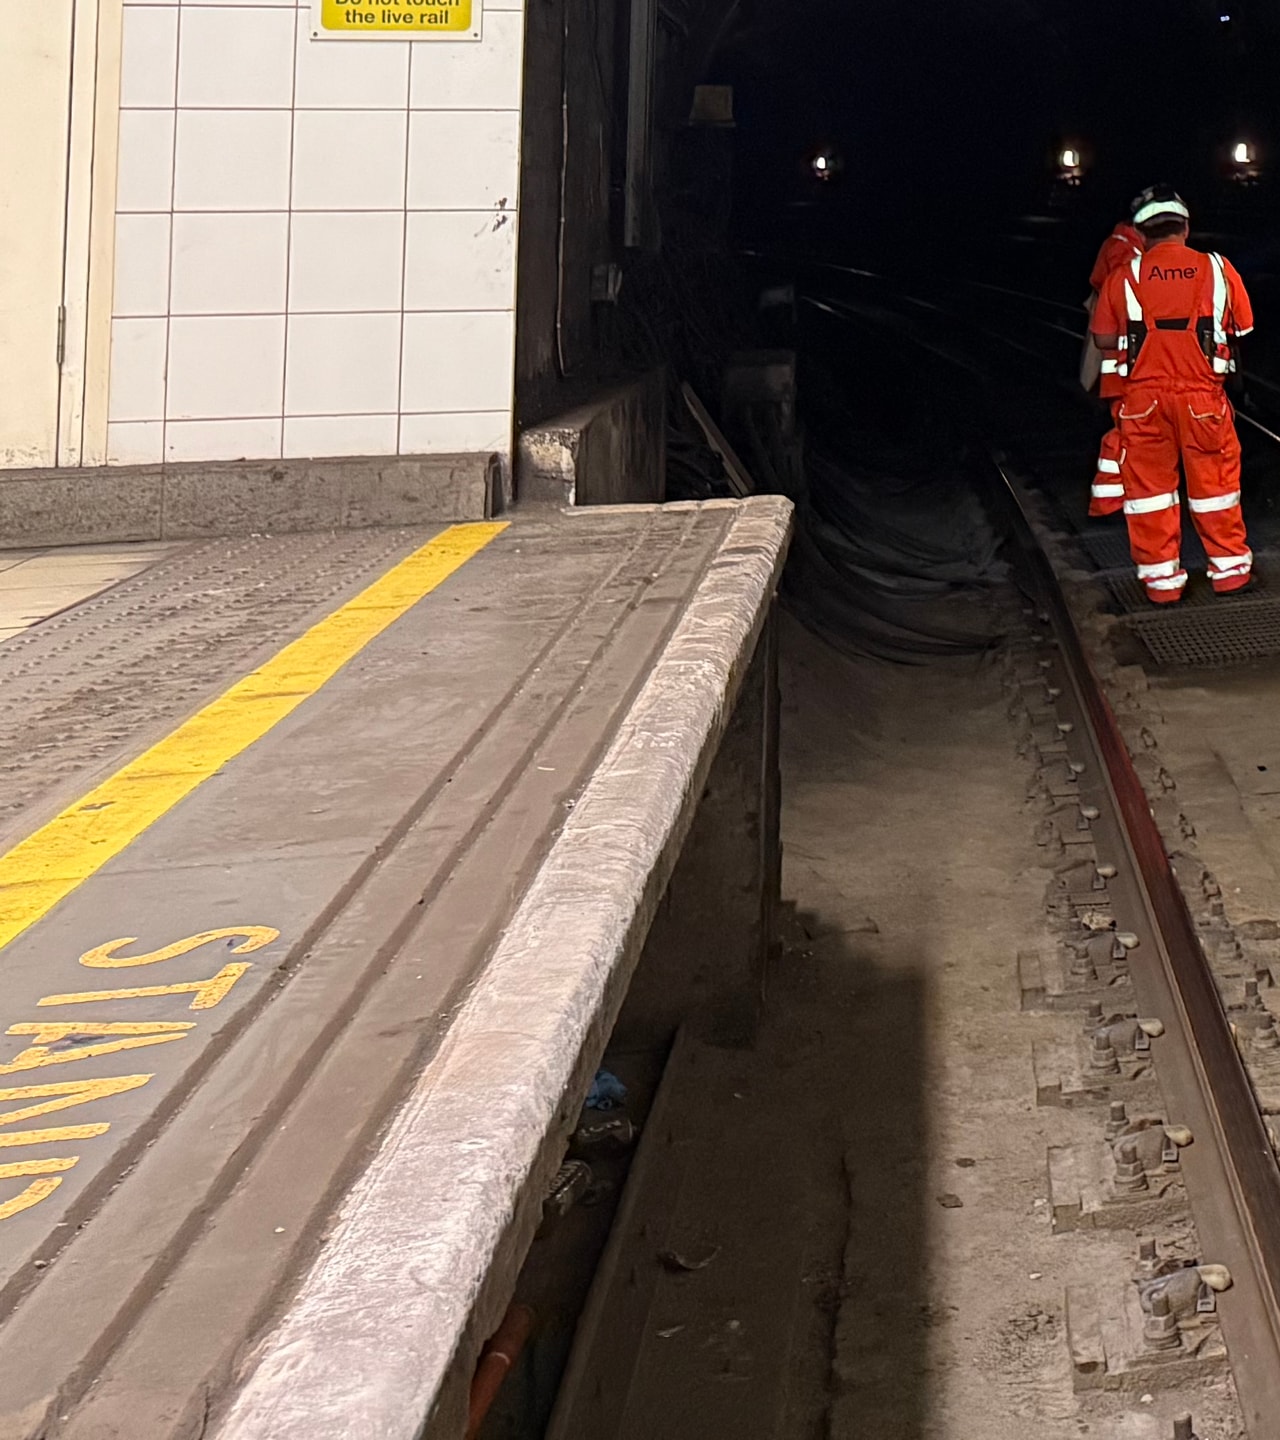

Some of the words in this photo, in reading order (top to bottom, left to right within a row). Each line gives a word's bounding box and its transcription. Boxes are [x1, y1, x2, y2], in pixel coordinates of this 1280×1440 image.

[345, 10, 376, 24] the
[381, 10, 414, 24] live
[420, 10, 449, 24] rail
[1148, 265, 1198, 281] Ame
